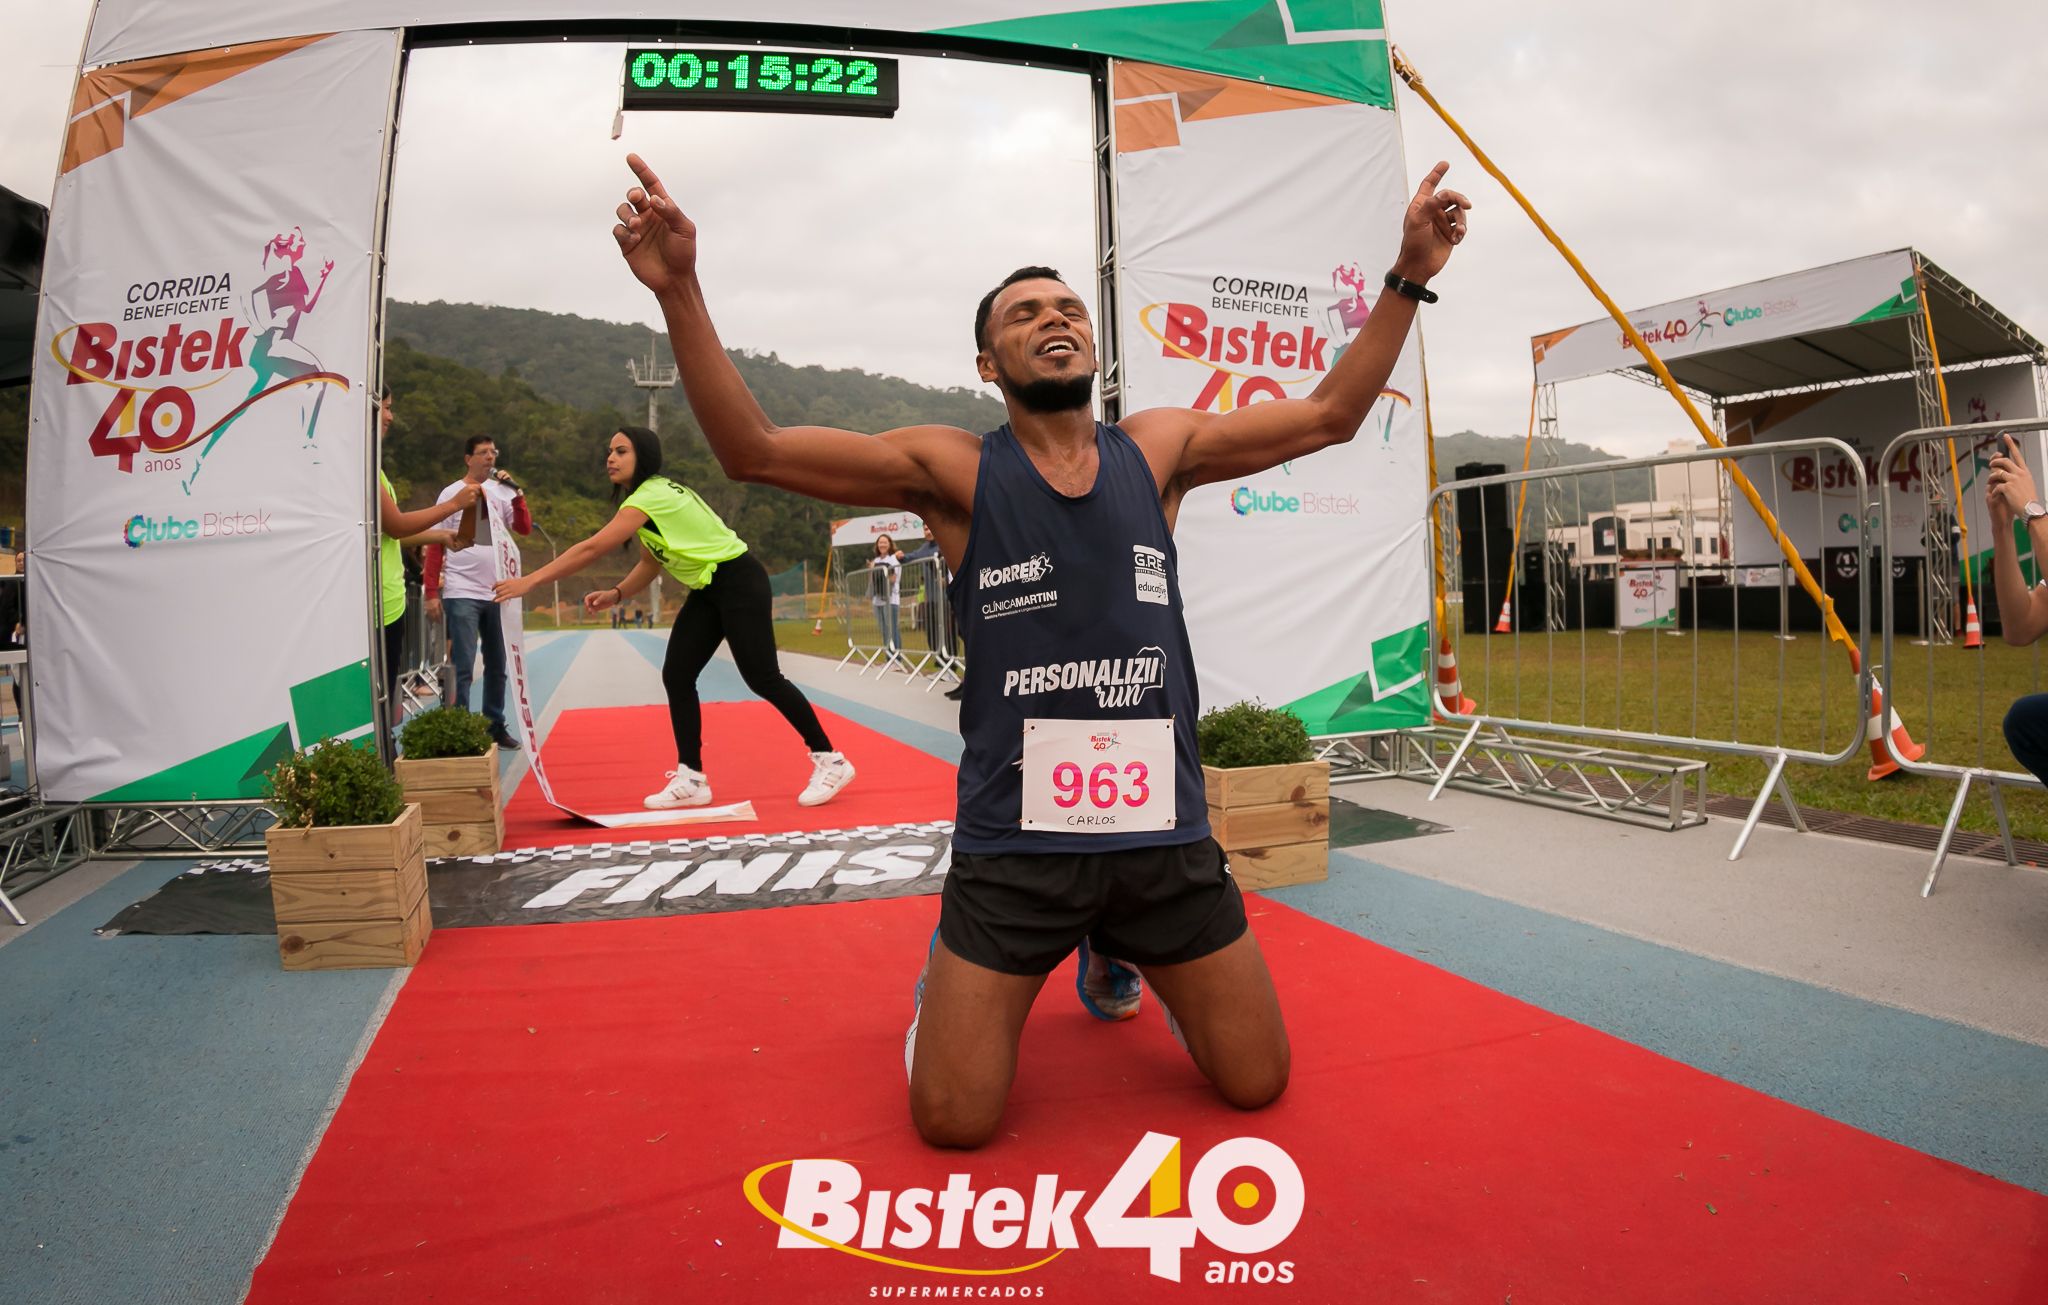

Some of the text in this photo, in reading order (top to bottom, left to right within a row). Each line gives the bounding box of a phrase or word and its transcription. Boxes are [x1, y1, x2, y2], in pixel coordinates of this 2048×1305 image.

[631, 52, 878, 95] 00:15:22
[126, 273, 231, 303] CORRIDA
[1212, 276, 1309, 303] CORRIDA
[123, 296, 229, 321] BENEFICENTE
[1212, 297, 1309, 318] BENEFICENTE
[1724, 297, 1799, 326] Clube Bistek
[1162, 303, 1328, 372] Bistek
[1663, 318, 1687, 343] 40
[66, 317, 250, 385] Bistek
[88, 386, 196, 474] 40
[144, 457, 182, 473] anos
[1232, 488, 1360, 515] Clube Bistek
[125, 509, 272, 545] Clube Bistek
[979, 560, 1041, 589] KORRER
[1094, 684, 1146, 709] run
[1090, 735, 1111, 743] Bistek
[1093, 742, 1106, 751] 40
[1052, 761, 1150, 809] 963
[1067, 815, 1116, 826] CARLOS
[521, 842, 953, 909] FINIS
